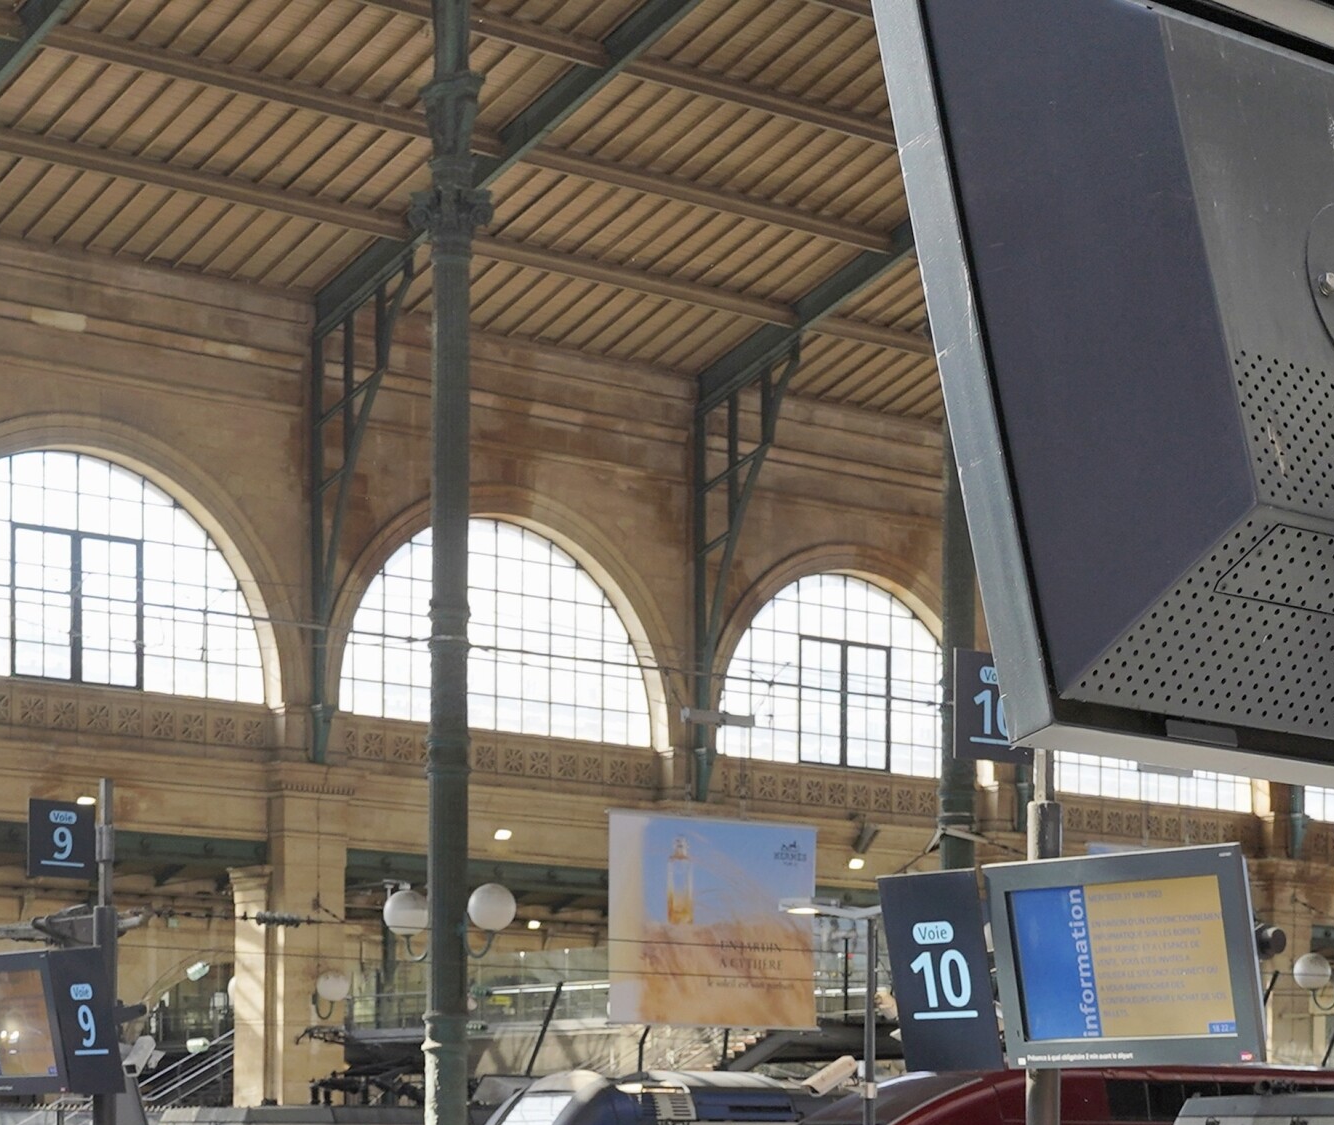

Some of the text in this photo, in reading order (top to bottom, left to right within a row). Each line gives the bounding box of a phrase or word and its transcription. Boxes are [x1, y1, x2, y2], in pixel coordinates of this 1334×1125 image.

[984, 669, 998, 681] Vo
[53, 812, 73, 822] Voie
[53, 826, 73, 859] 9
[918, 925, 948, 940] Voie
[1068, 888, 1099, 1037] information
[910, 949, 972, 1008] 10
[73, 986, 90, 998] Voie
[78, 1004, 96, 1047] 9
